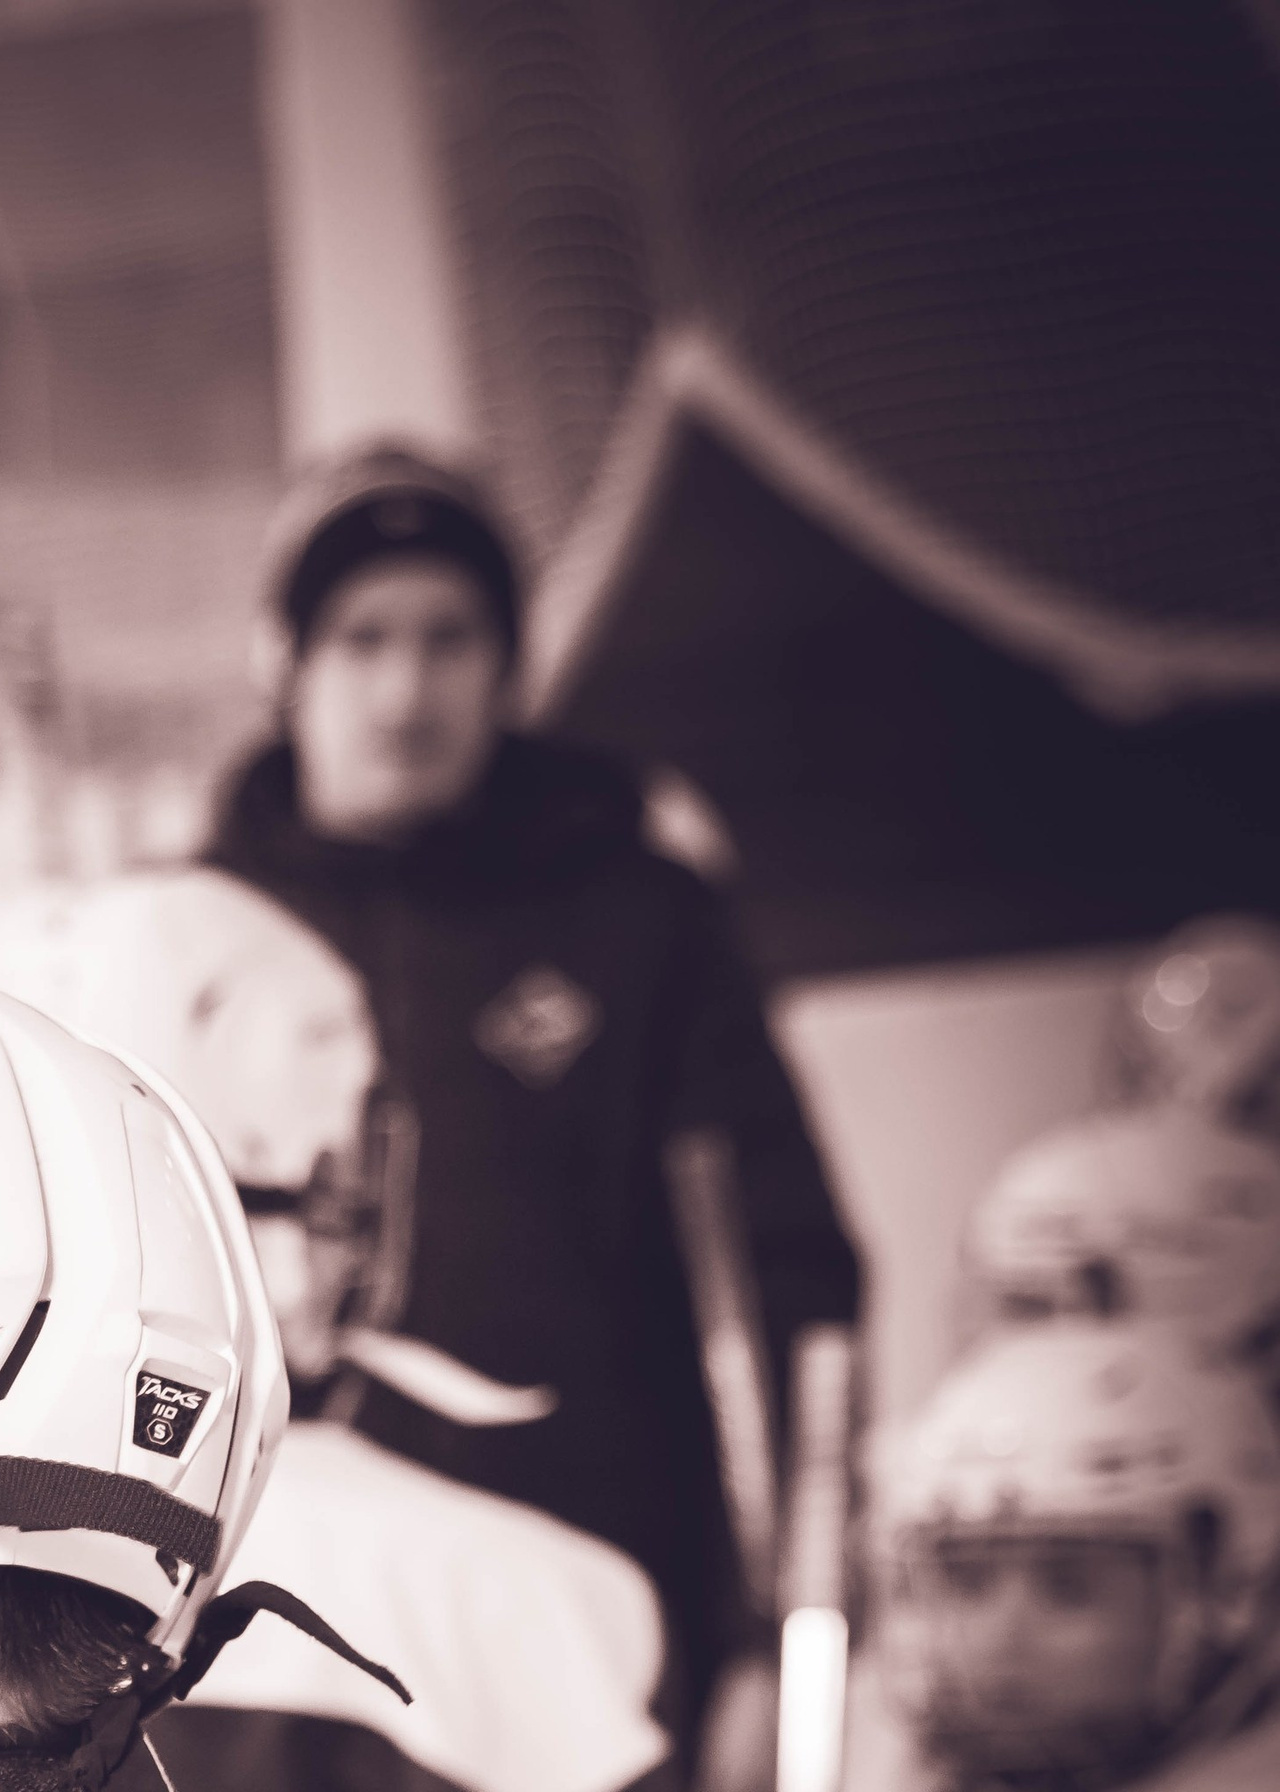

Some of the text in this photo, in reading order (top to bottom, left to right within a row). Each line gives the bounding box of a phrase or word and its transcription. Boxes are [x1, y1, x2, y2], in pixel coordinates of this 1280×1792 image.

[136, 1376, 203, 1410] TACKS
[152, 1403, 179, 1420] 110
[153, 1423, 166, 1440] S
